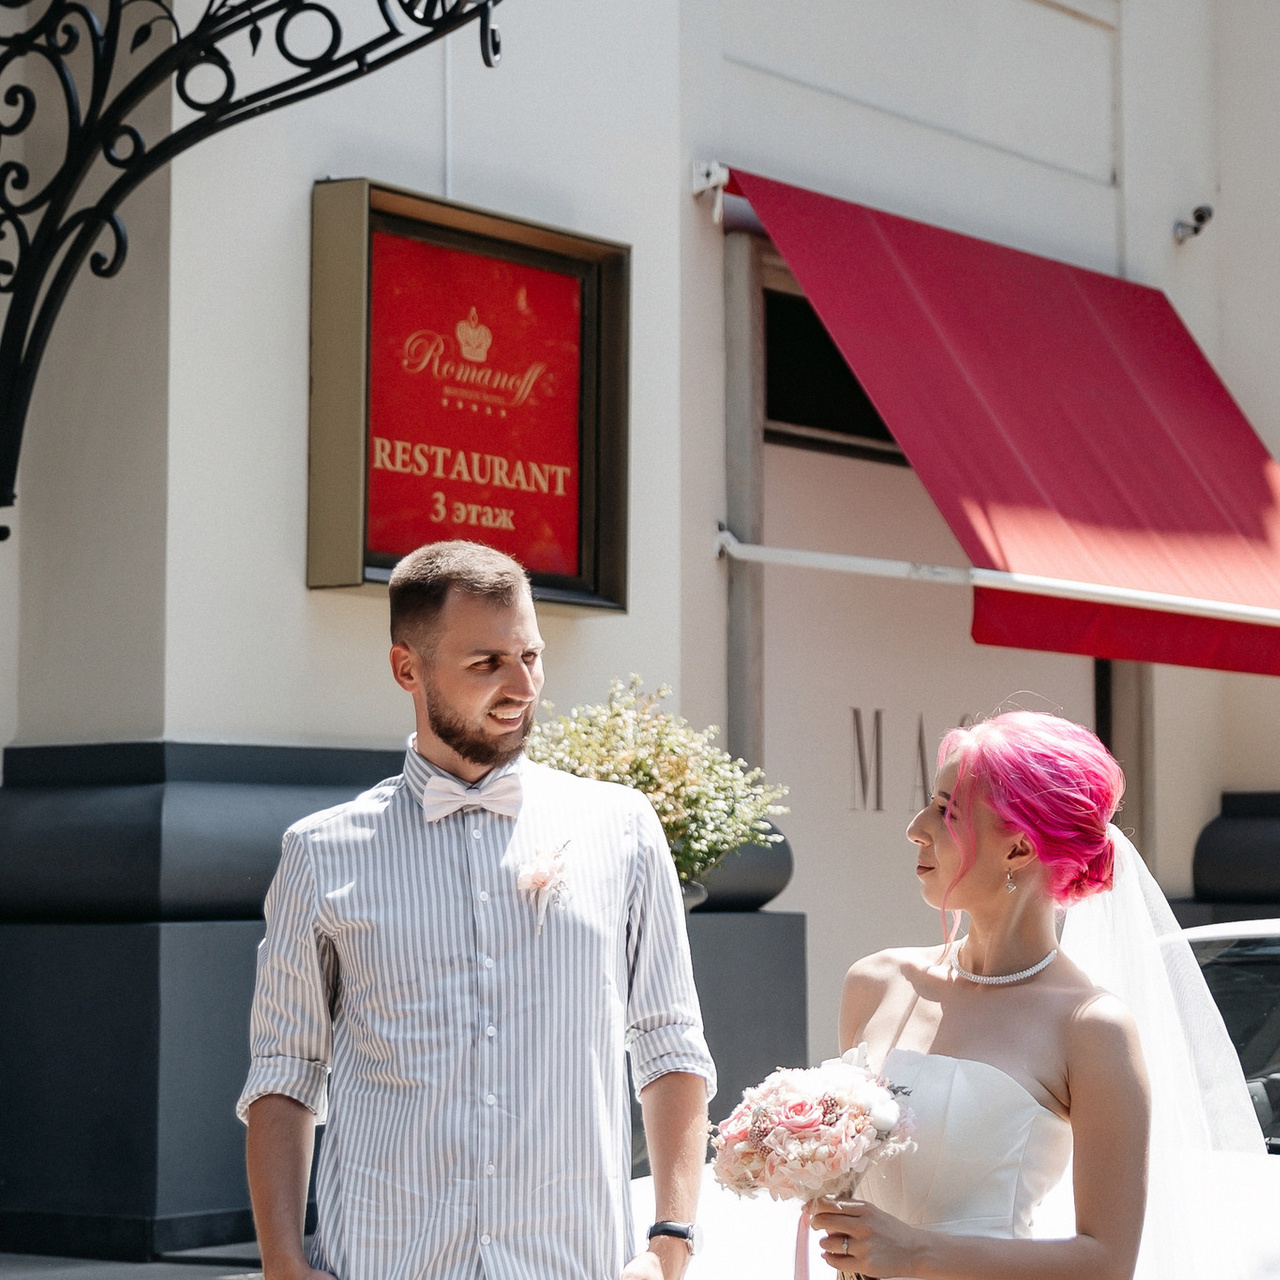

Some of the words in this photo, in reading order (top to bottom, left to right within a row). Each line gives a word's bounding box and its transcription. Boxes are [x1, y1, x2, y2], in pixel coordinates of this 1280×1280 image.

[402, 329, 547, 407] Romanoff
[373, 437, 571, 497] RESTAURANT
[431, 492, 447, 522] 3
[454, 502, 515, 529] этаж
